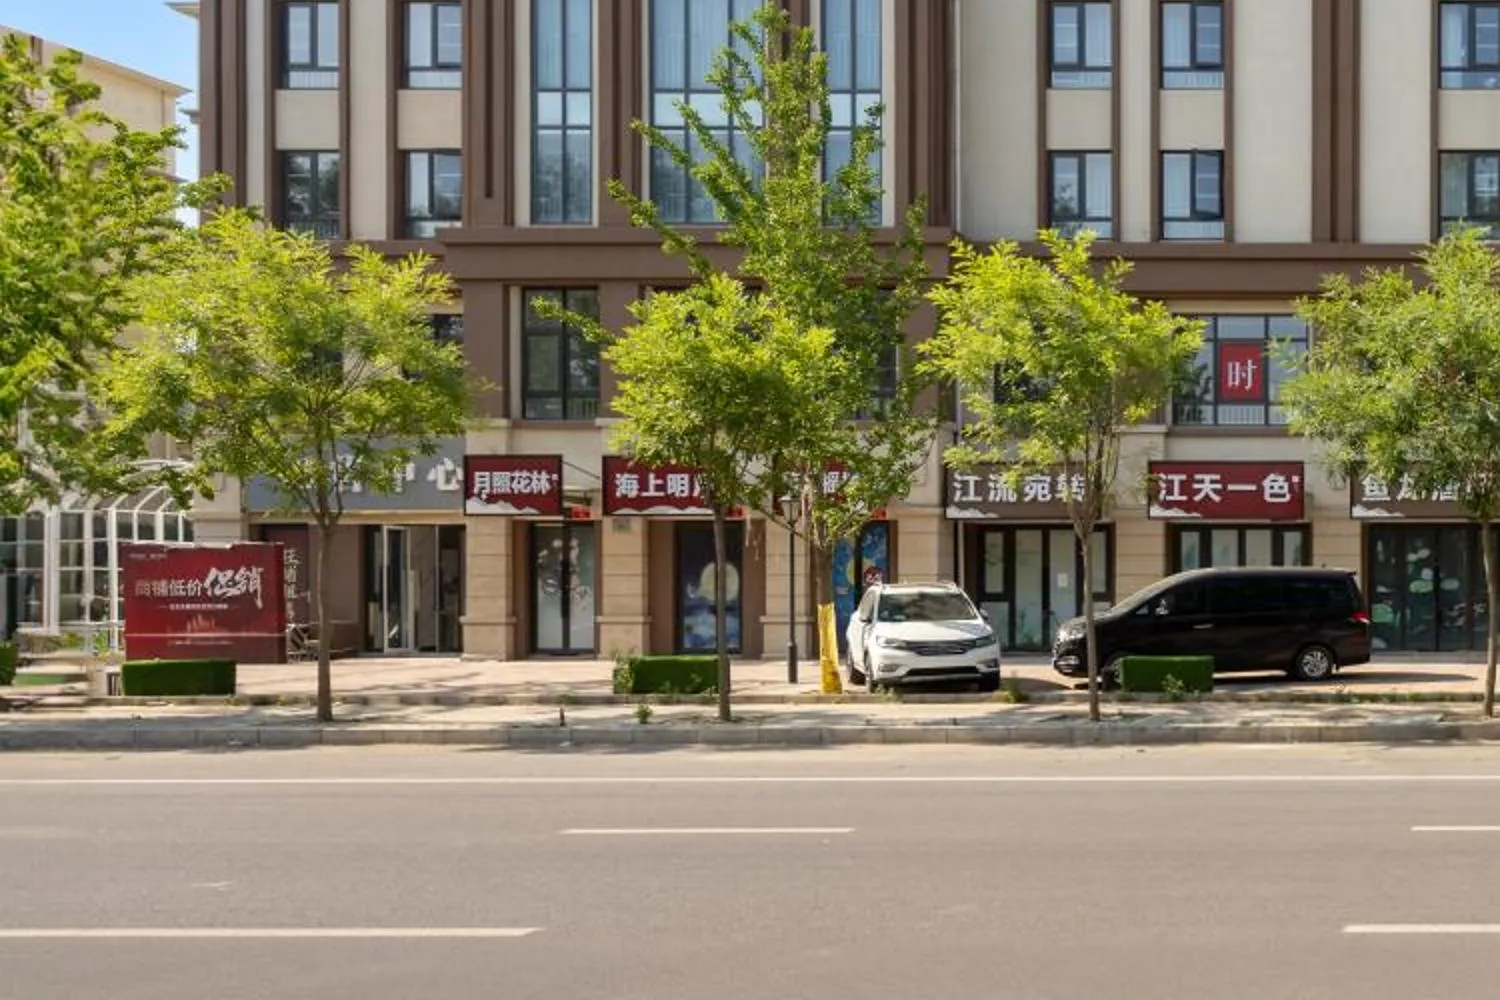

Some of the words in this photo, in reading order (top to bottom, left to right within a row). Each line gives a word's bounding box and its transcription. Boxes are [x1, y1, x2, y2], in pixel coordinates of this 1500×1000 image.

[1228, 359, 1258, 391] 时
[473, 469, 551, 499] 月照花林
[1159, 472, 1292, 503] 江天一色
